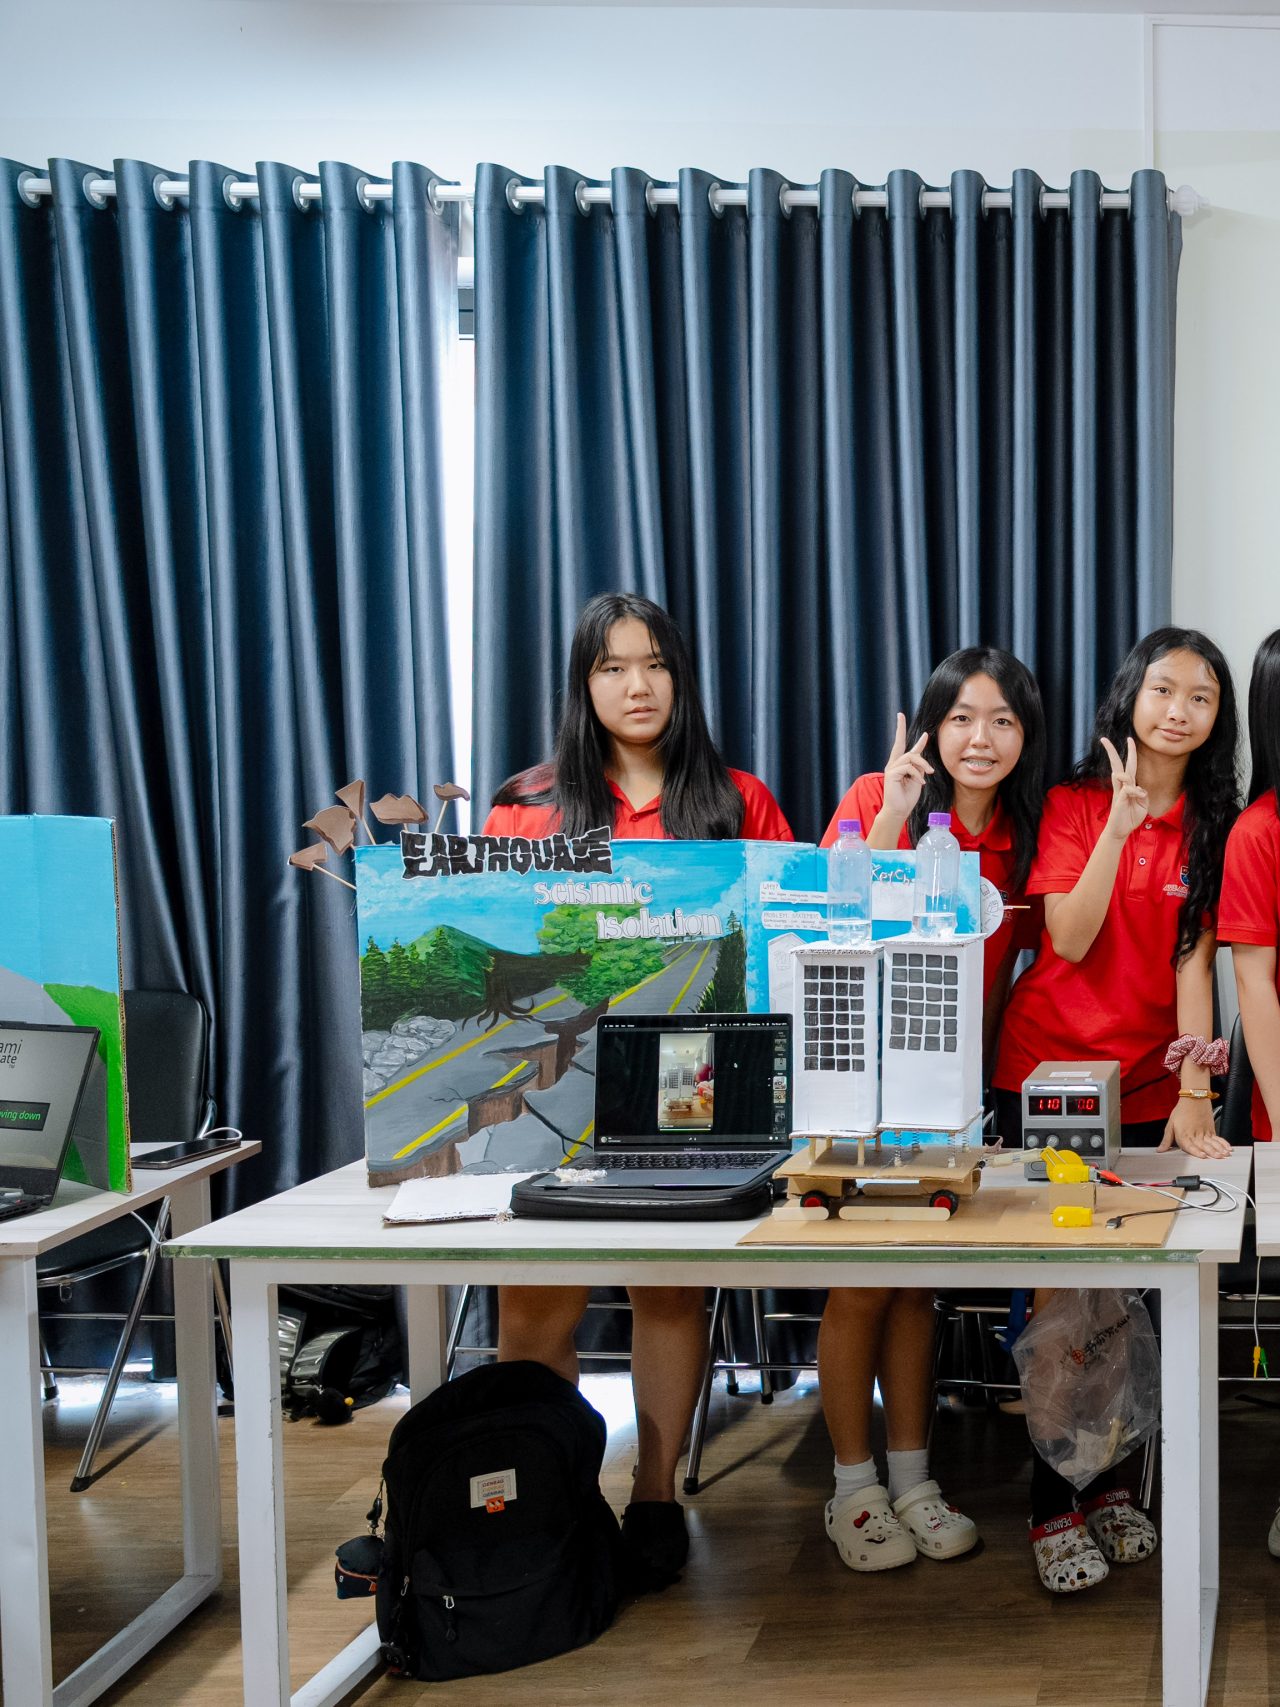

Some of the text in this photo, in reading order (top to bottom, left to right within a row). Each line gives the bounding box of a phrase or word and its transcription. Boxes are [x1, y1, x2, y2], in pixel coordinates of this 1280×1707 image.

[402, 827, 612, 878] EARTHQUAKE
[534, 877, 653, 904] seismic
[596, 908, 723, 938] isolation
[19, 1111, 41, 1121] down
[1044, 1517, 1072, 1533] PEANUTS
